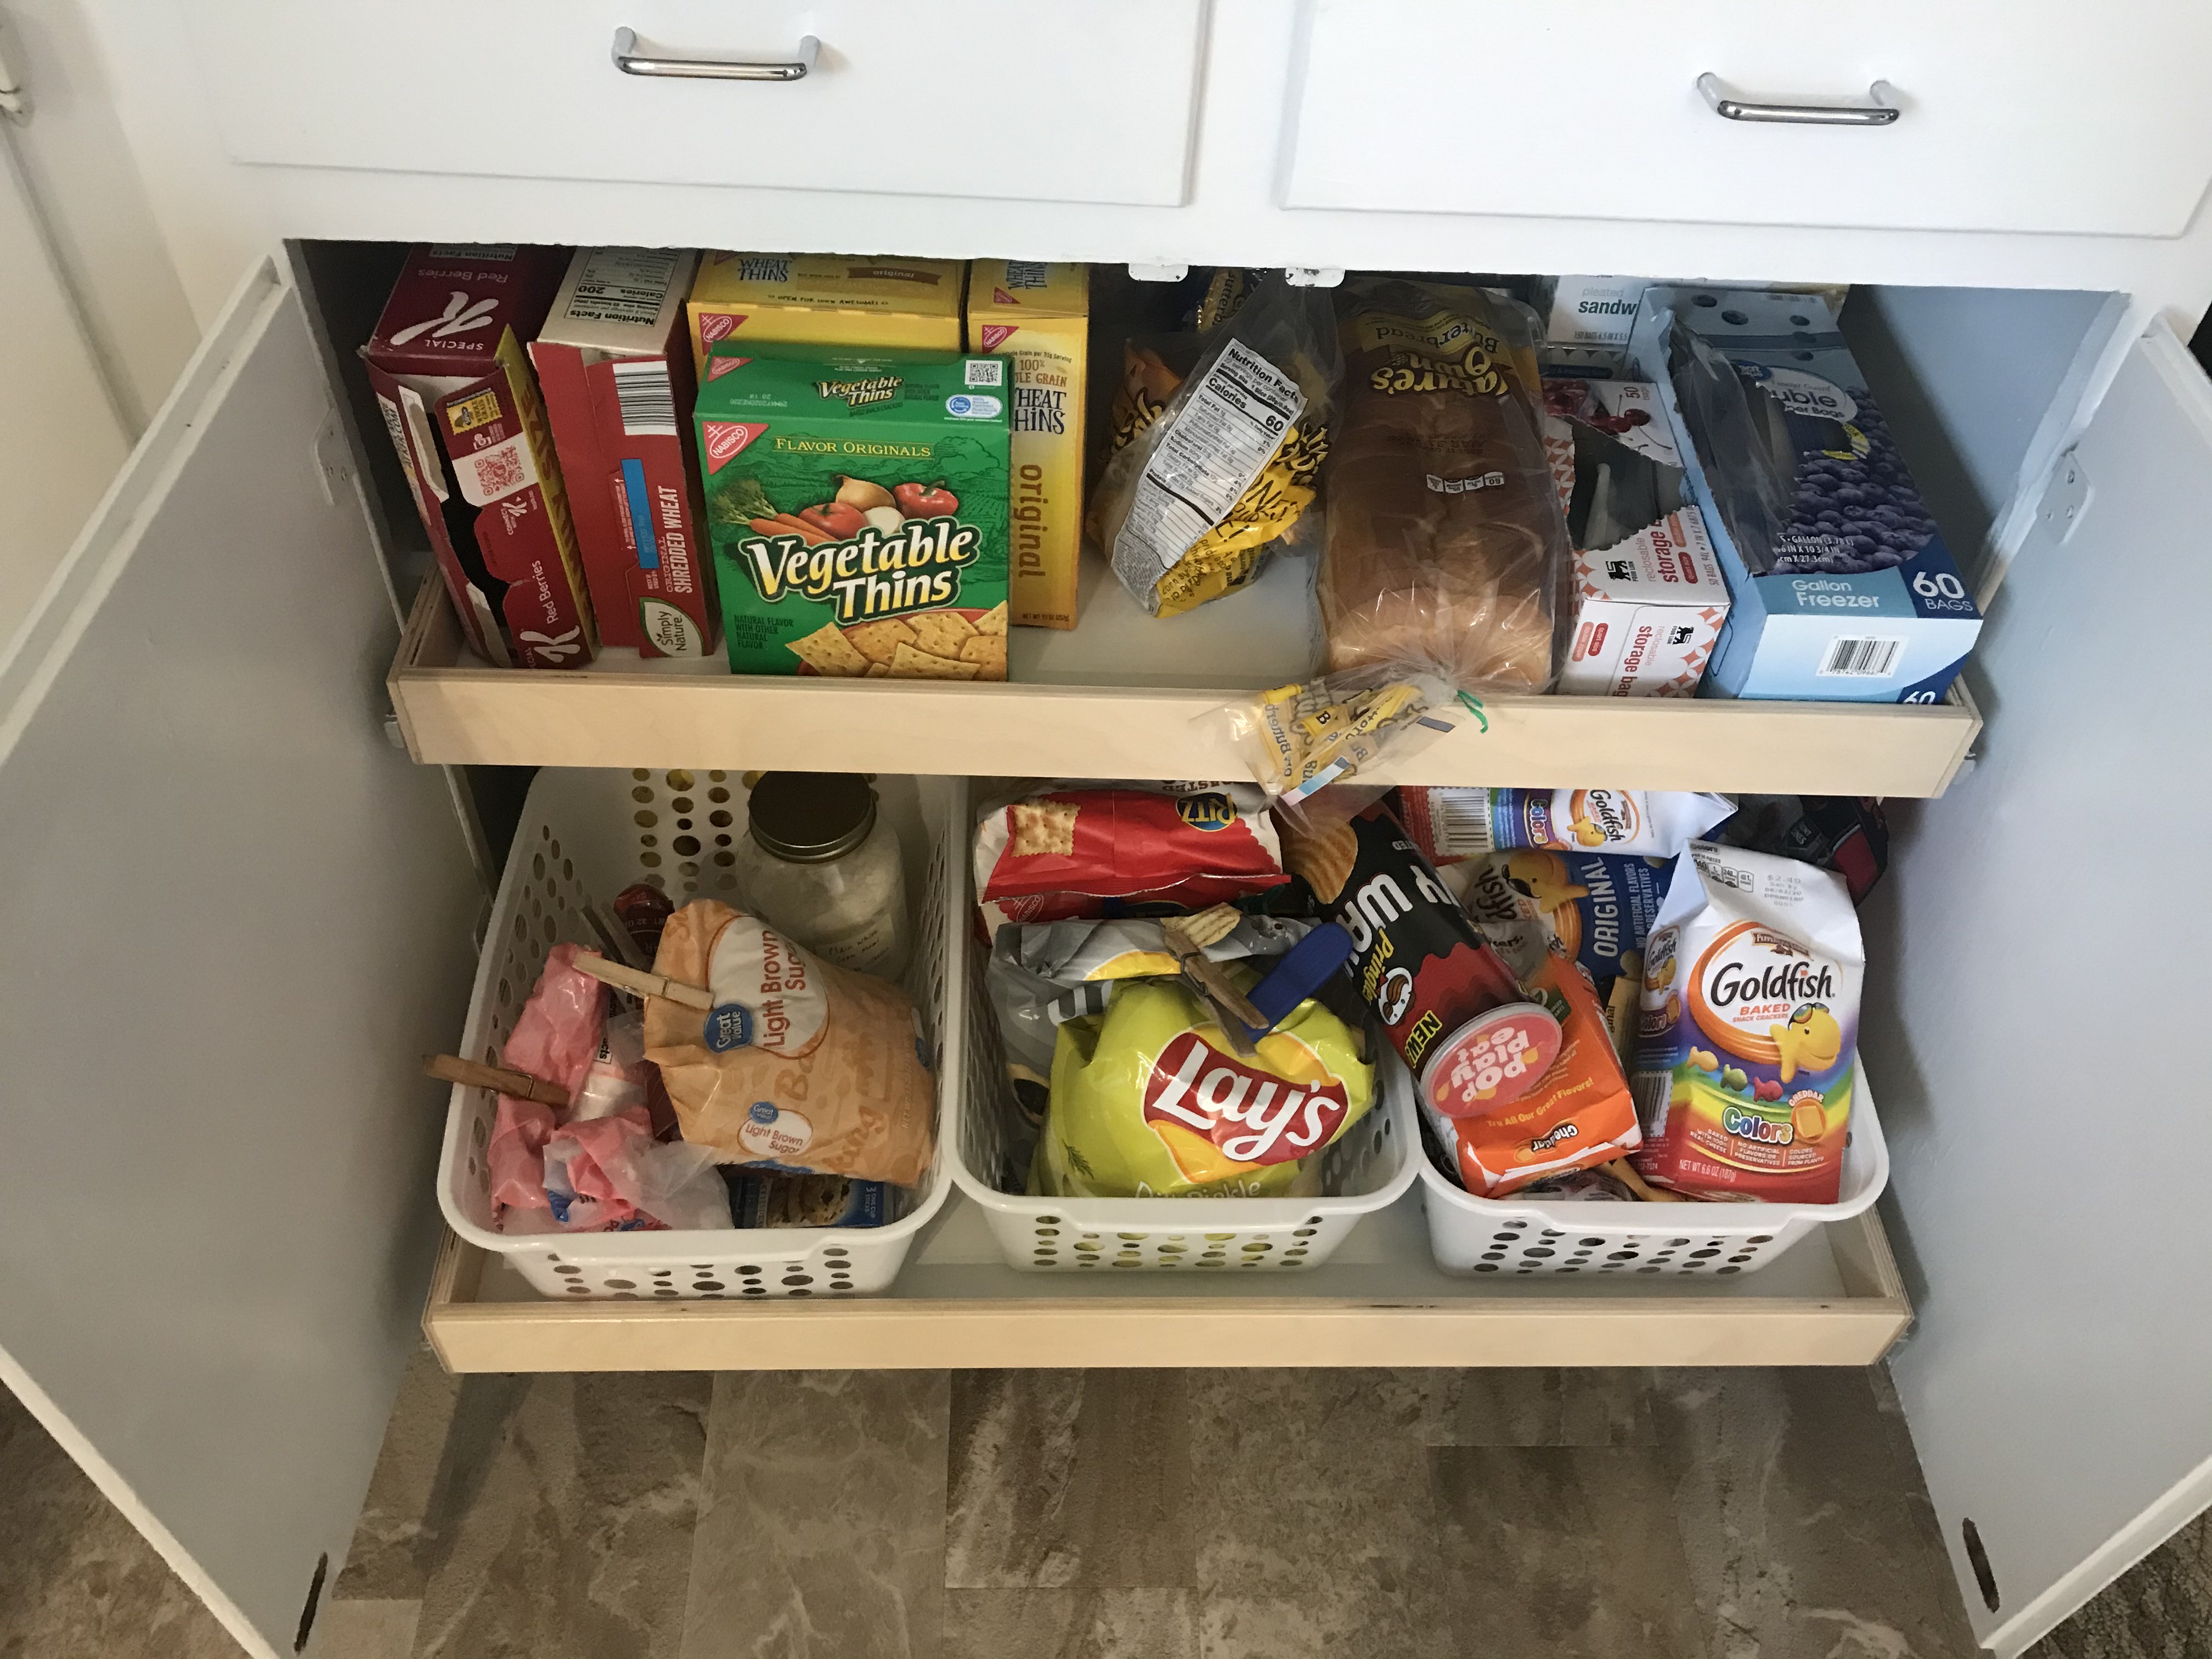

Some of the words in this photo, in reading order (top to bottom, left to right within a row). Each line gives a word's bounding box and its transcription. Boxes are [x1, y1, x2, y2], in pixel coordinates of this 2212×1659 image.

[417, 269, 472, 280] Berries
[738, 258, 791, 270] WHEAT
[873, 269, 915, 278] original
[477, 273, 508, 283] Red
[578, 286, 605, 294] 200
[620, 289, 663, 298] Calories
[1582, 287, 1624, 297] pleated
[569, 310, 601, 319] Facts
[1578, 300, 1638, 315] sandw
[605, 314, 654, 325] Nutrition
[704, 317, 730, 342] NABISCO
[424, 339, 483, 350] SPECIAL
[1376, 323, 1500, 354] Butterbread
[1020, 359, 1045, 371] 100%
[1053, 353, 1072, 363] Serving
[1409, 346, 1491, 376] Own
[1036, 373, 1067, 387] GRAIN
[1220, 362, 1239, 377] Serving
[1238, 375, 1249, 385] size
[1254, 386, 1268, 398] Slice
[1224, 357, 1233, 365] 22
[1231, 362, 1254, 381] servings
[1252, 378, 1263, 388] per
[1262, 383, 1288, 404] container
[1228, 347, 1274, 385] Nutrition
[1272, 379, 1302, 404] Facts
[816, 376, 904, 399] Vegetable
[848, 387, 894, 405] Thins
[1015, 388, 1067, 409] HEAT
[1626, 387, 1641, 398] 50
[1770, 388, 1837, 408] uble
[1207, 376, 1249, 410] Calories
[1264, 413, 1286, 434] 60
[1812, 407, 1844, 419] Bags
[1198, 394, 1212, 407] Total
[1211, 403, 1221, 413] Fat
[1262, 439, 1271, 448] 1%
[1205, 420, 1215, 429] Fat
[712, 427, 746, 459] NABISCO
[776, 438, 837, 453] FLAVOR
[843, 442, 930, 458] ORIGINALS
[1174, 428, 1204, 452] Cholesterol
[1222, 442, 1231, 450] Fat
[1165, 442, 1180, 455] Total
[1178, 451, 1211, 477] Carbohydrate
[1169, 436, 1189, 452] Sodium
[1187, 448, 1202, 460] 90mg
[1233, 479, 1243, 488] 4%
[1219, 450, 1228, 459] Fat
[1148, 468, 1167, 484] Protein
[658, 486, 681, 529] WHEAT
[501, 508, 514, 534] CONNECT
[1018, 464, 1046, 578] original
[1792, 534, 1822, 544] GALLON
[1816, 546, 1830, 555] 3/4
[658, 536, 673, 592] ORIGINAL
[664, 531, 692, 593] SHREDDED
[746, 522, 974, 597] Vegetable
[1637, 537, 1656, 582] reclosable
[1651, 531, 1679, 583] storage
[1800, 555, 1833, 564] 27.3cm)
[531, 560, 555, 603] Berries
[1704, 563, 1716, 577] BAGS
[833, 569, 952, 619] Thins
[1792, 579, 1852, 591] Gallon
[1913, 571, 1965, 599] 60
[1797, 592, 1879, 607] Freezer
[1927, 598, 1973, 611] BAGS
[547, 600, 559, 624] Red
[735, 614, 765, 624] NATURAL
[768, 617, 793, 627] FLAVOR
[657, 610, 673, 647] Simply
[674, 617, 687, 651] Nature
[736, 624, 754, 632] WITH
[755, 625, 778, 635] OTHER
[737, 632, 768, 642] NATURAL
[1595, 627, 1604, 640] quart
[738, 641, 764, 650] FLAVOR
[1624, 626, 1652, 678] storage
[1645, 626, 1665, 666] reclosable
[1181, 793, 1234, 824] RITZ
[1591, 790, 1626, 842] Goldfish
[1530, 798, 1549, 844] Colors
[1623, 862, 1638, 892] FLAVORS
[1581, 856, 1619, 957] ORIGINAL
[1629, 894, 1643, 936] ARTIFICIAL
[1637, 937, 1646, 948] NO
[1648, 937, 1677, 969] Goldfish
[760, 931, 780, 994] Brown
[1362, 928, 1394, 1004] Pringles
[1710, 961, 1832, 1007] Goldfish
[1740, 1003, 1791, 1016] BAKED
[716, 1013, 731, 1048] Great
[731, 1011, 742, 1040] Value
[764, 1000, 791, 1048] Light
[1406, 1011, 1442, 1067] NEW!
[1457, 1026, 1515, 1062] eat
[1451, 1030, 1530, 1088] play
[1462, 1053, 1527, 1102] pop
[1153, 1040, 1340, 1161] Lay's
[1505, 1115, 1517, 1126] All
[1519, 1112, 1534, 1122] Our
[1536, 1096, 1557, 1116] Great
[1558, 1077, 1594, 1099] Flavors!
[1788, 1090, 1824, 1107] CHEDDAR
[753, 1104, 774, 1117] Great
[745, 1124, 771, 1138] Light
[772, 1131, 804, 1147] Brown
[1697, 1130, 1712, 1141] WITH
[1708, 1128, 1728, 1142] BAKED
[1725, 1108, 1793, 1143] Colors
[769, 1140, 800, 1154] Sugar
[1532, 1124, 1578, 1152] Cheddar
[1690, 1131, 1705, 1144] REAL
[1706, 1140, 1727, 1153] CHEESE
[1748, 1143, 1780, 1154] ARTIFICIAL
[1734, 1152, 1780, 1165] PRESERVATIVES
[1740, 1147, 1767, 1158] FLAVORS
[1803, 1156, 1825, 1164] PLANTS
[1679, 1159, 1690, 1170] NET
[1691, 1161, 1701, 1171] WT
[1701, 1163, 1712, 1175] 6.6
[1712, 1165, 1719, 1176] OZ
[1719, 1166, 1736, 1182] (187g)
